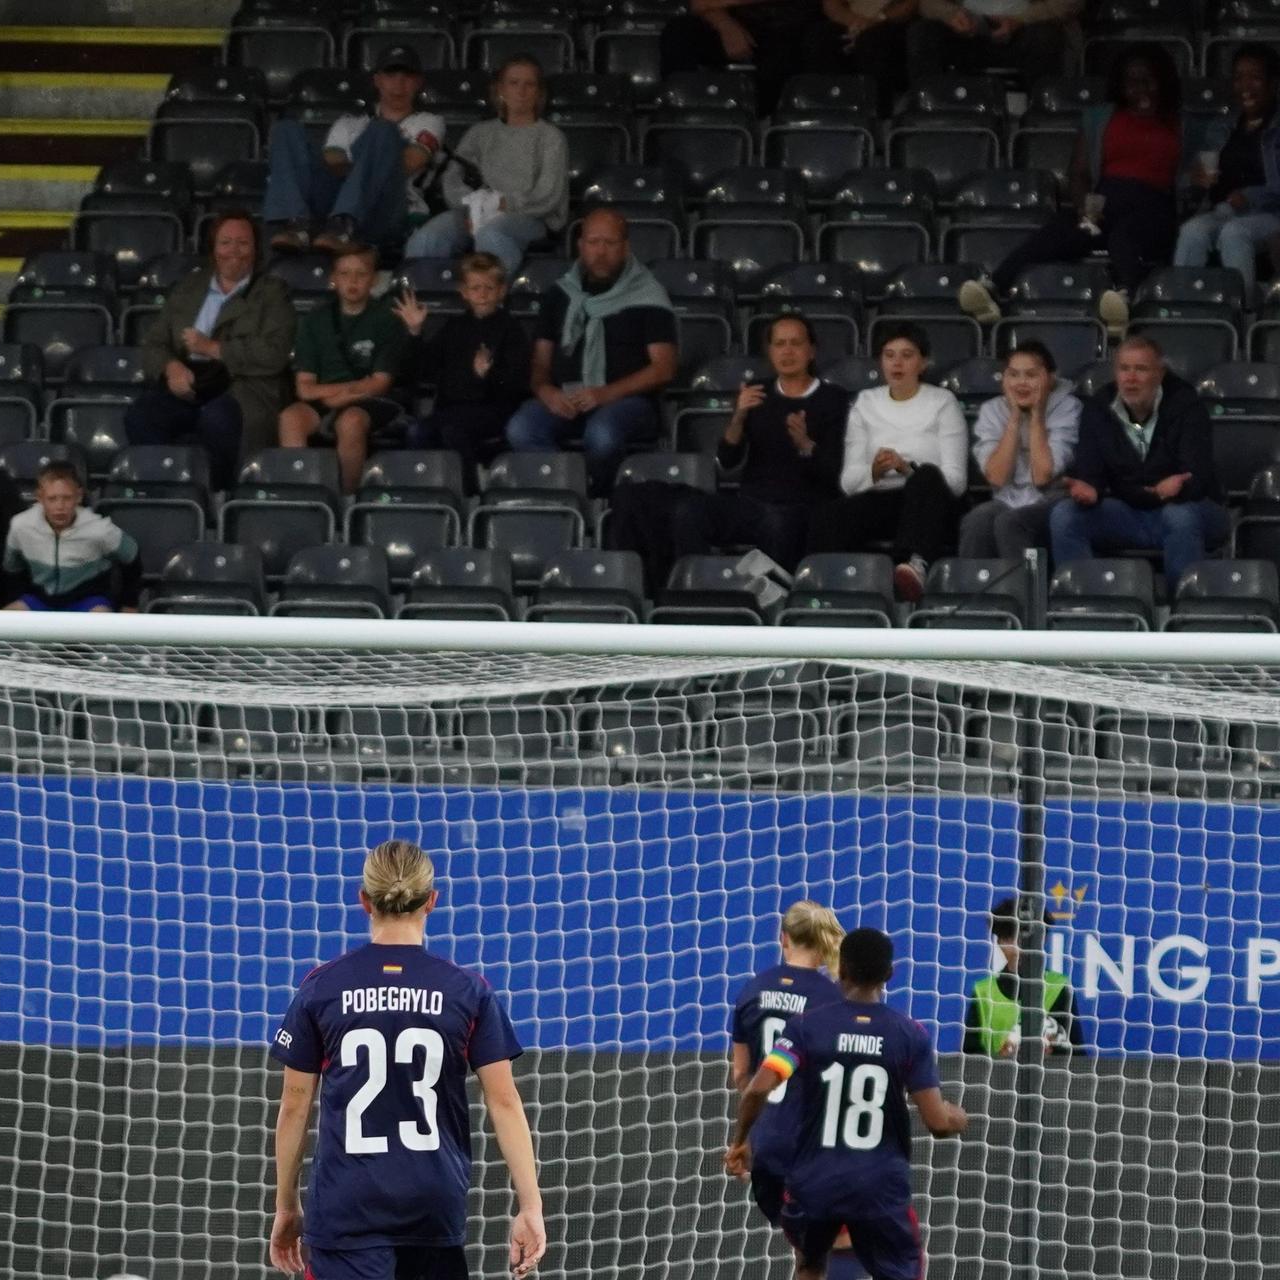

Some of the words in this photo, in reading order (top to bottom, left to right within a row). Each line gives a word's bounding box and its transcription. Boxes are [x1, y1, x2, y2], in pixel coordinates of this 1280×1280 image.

[991, 932, 1211, 1002] ING
[341, 986, 443, 1015] POBEGAYLO
[759, 990, 807, 1014] JANSSON
[837, 1033, 884, 1056] AYINDE
[341, 1027, 445, 1154] 23
[821, 1061, 889, 1149] 18
